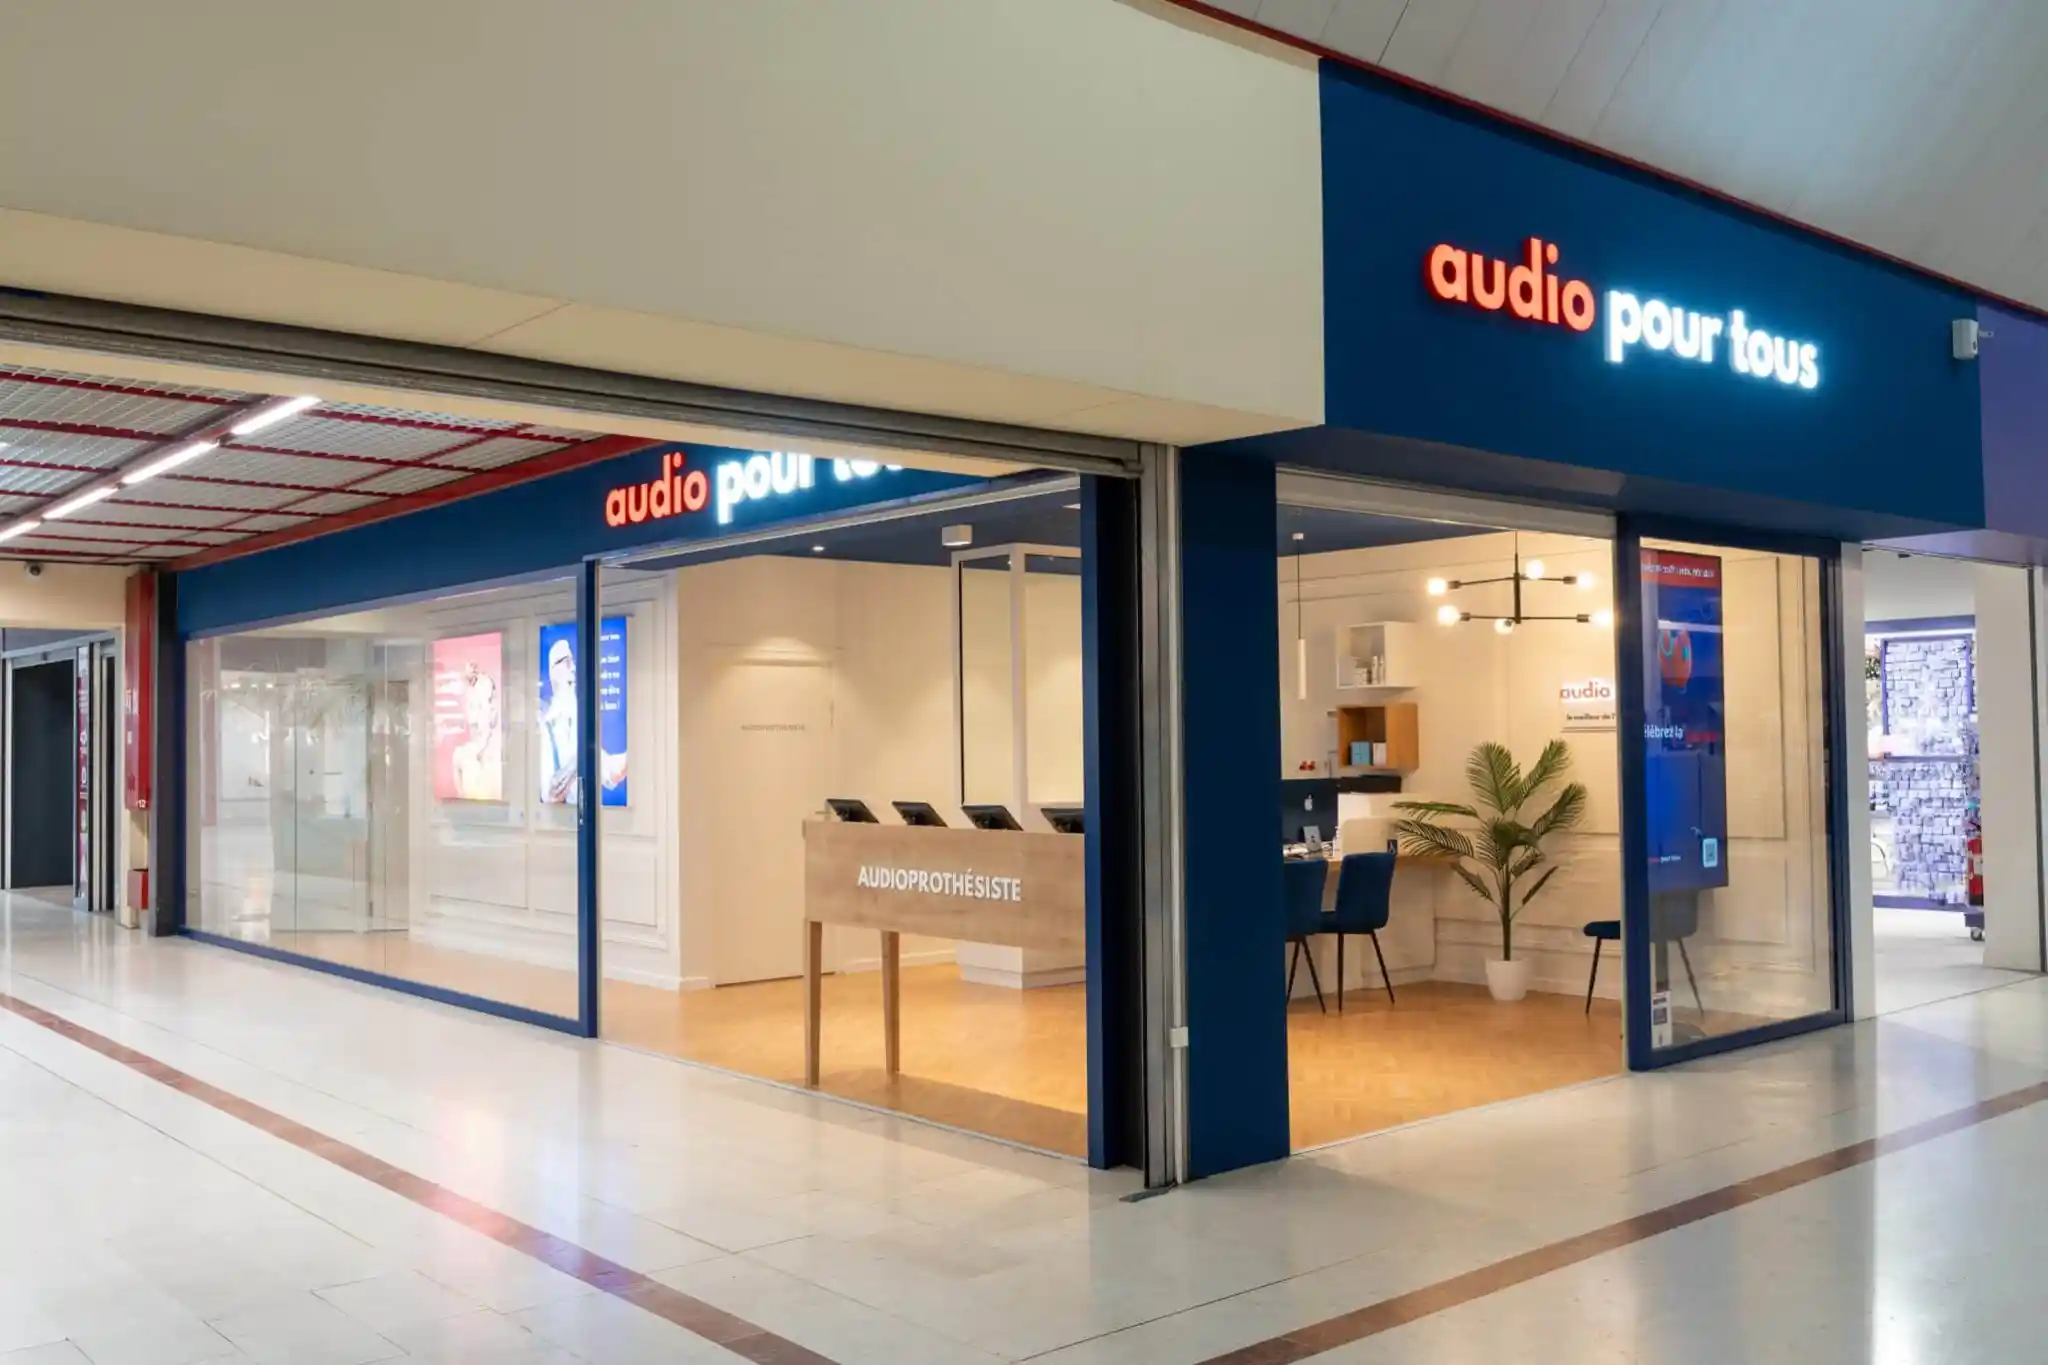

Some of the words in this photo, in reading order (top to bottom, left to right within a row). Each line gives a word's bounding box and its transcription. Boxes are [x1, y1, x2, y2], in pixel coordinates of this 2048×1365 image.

[1426, 236, 1597, 332] audio
[1604, 289, 1723, 363] pour
[1727, 309, 1820, 390] tous
[605, 451, 709, 528] audio
[1559, 681, 1611, 699] audio
[857, 864, 1022, 902] AUDIOPROTHÉSISTE
